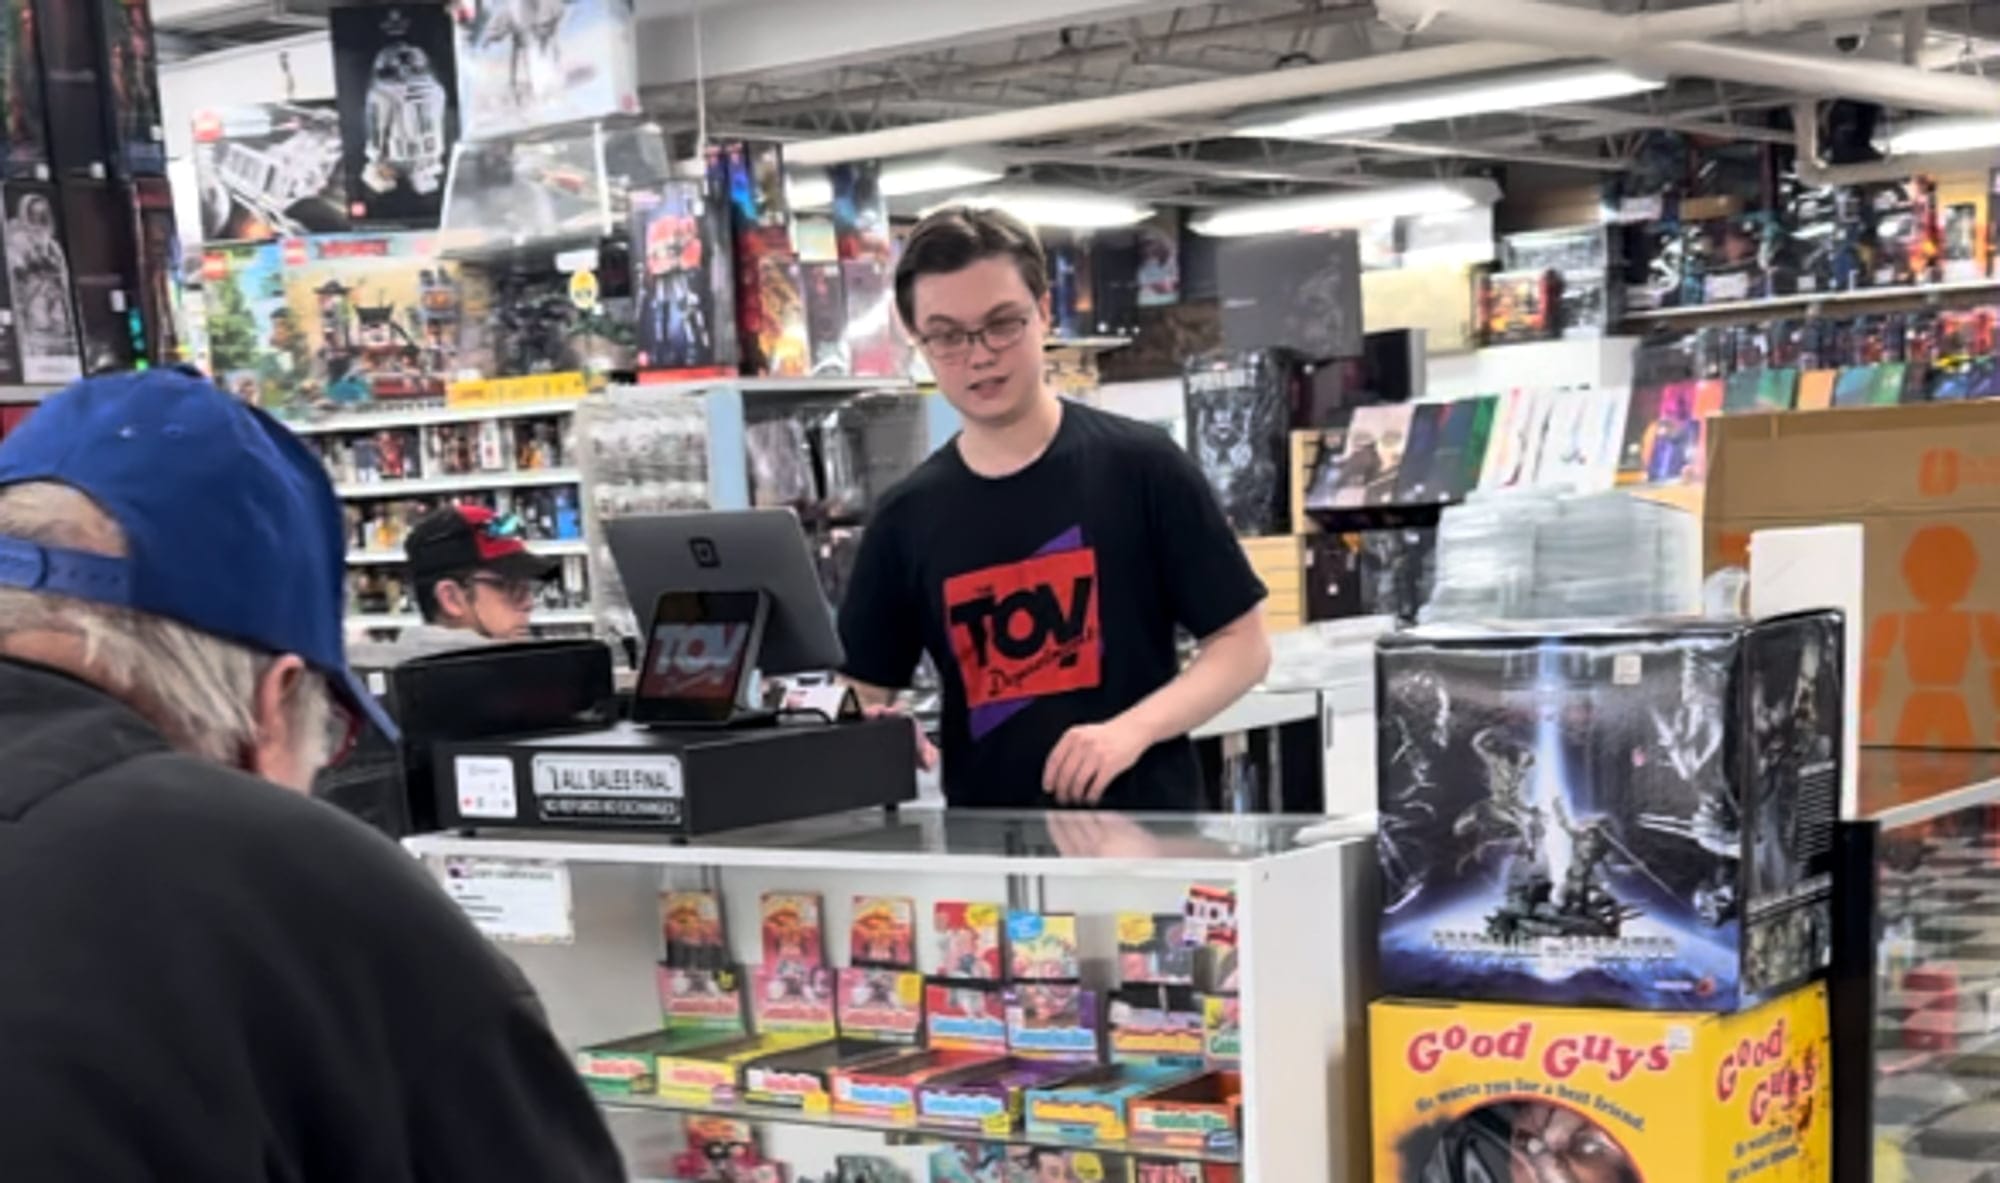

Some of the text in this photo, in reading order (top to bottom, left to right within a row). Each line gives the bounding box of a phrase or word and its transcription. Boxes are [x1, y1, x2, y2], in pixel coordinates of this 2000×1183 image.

[1407, 1022, 1670, 1082] Good Guys
[1716, 1018, 1784, 1101] Good
